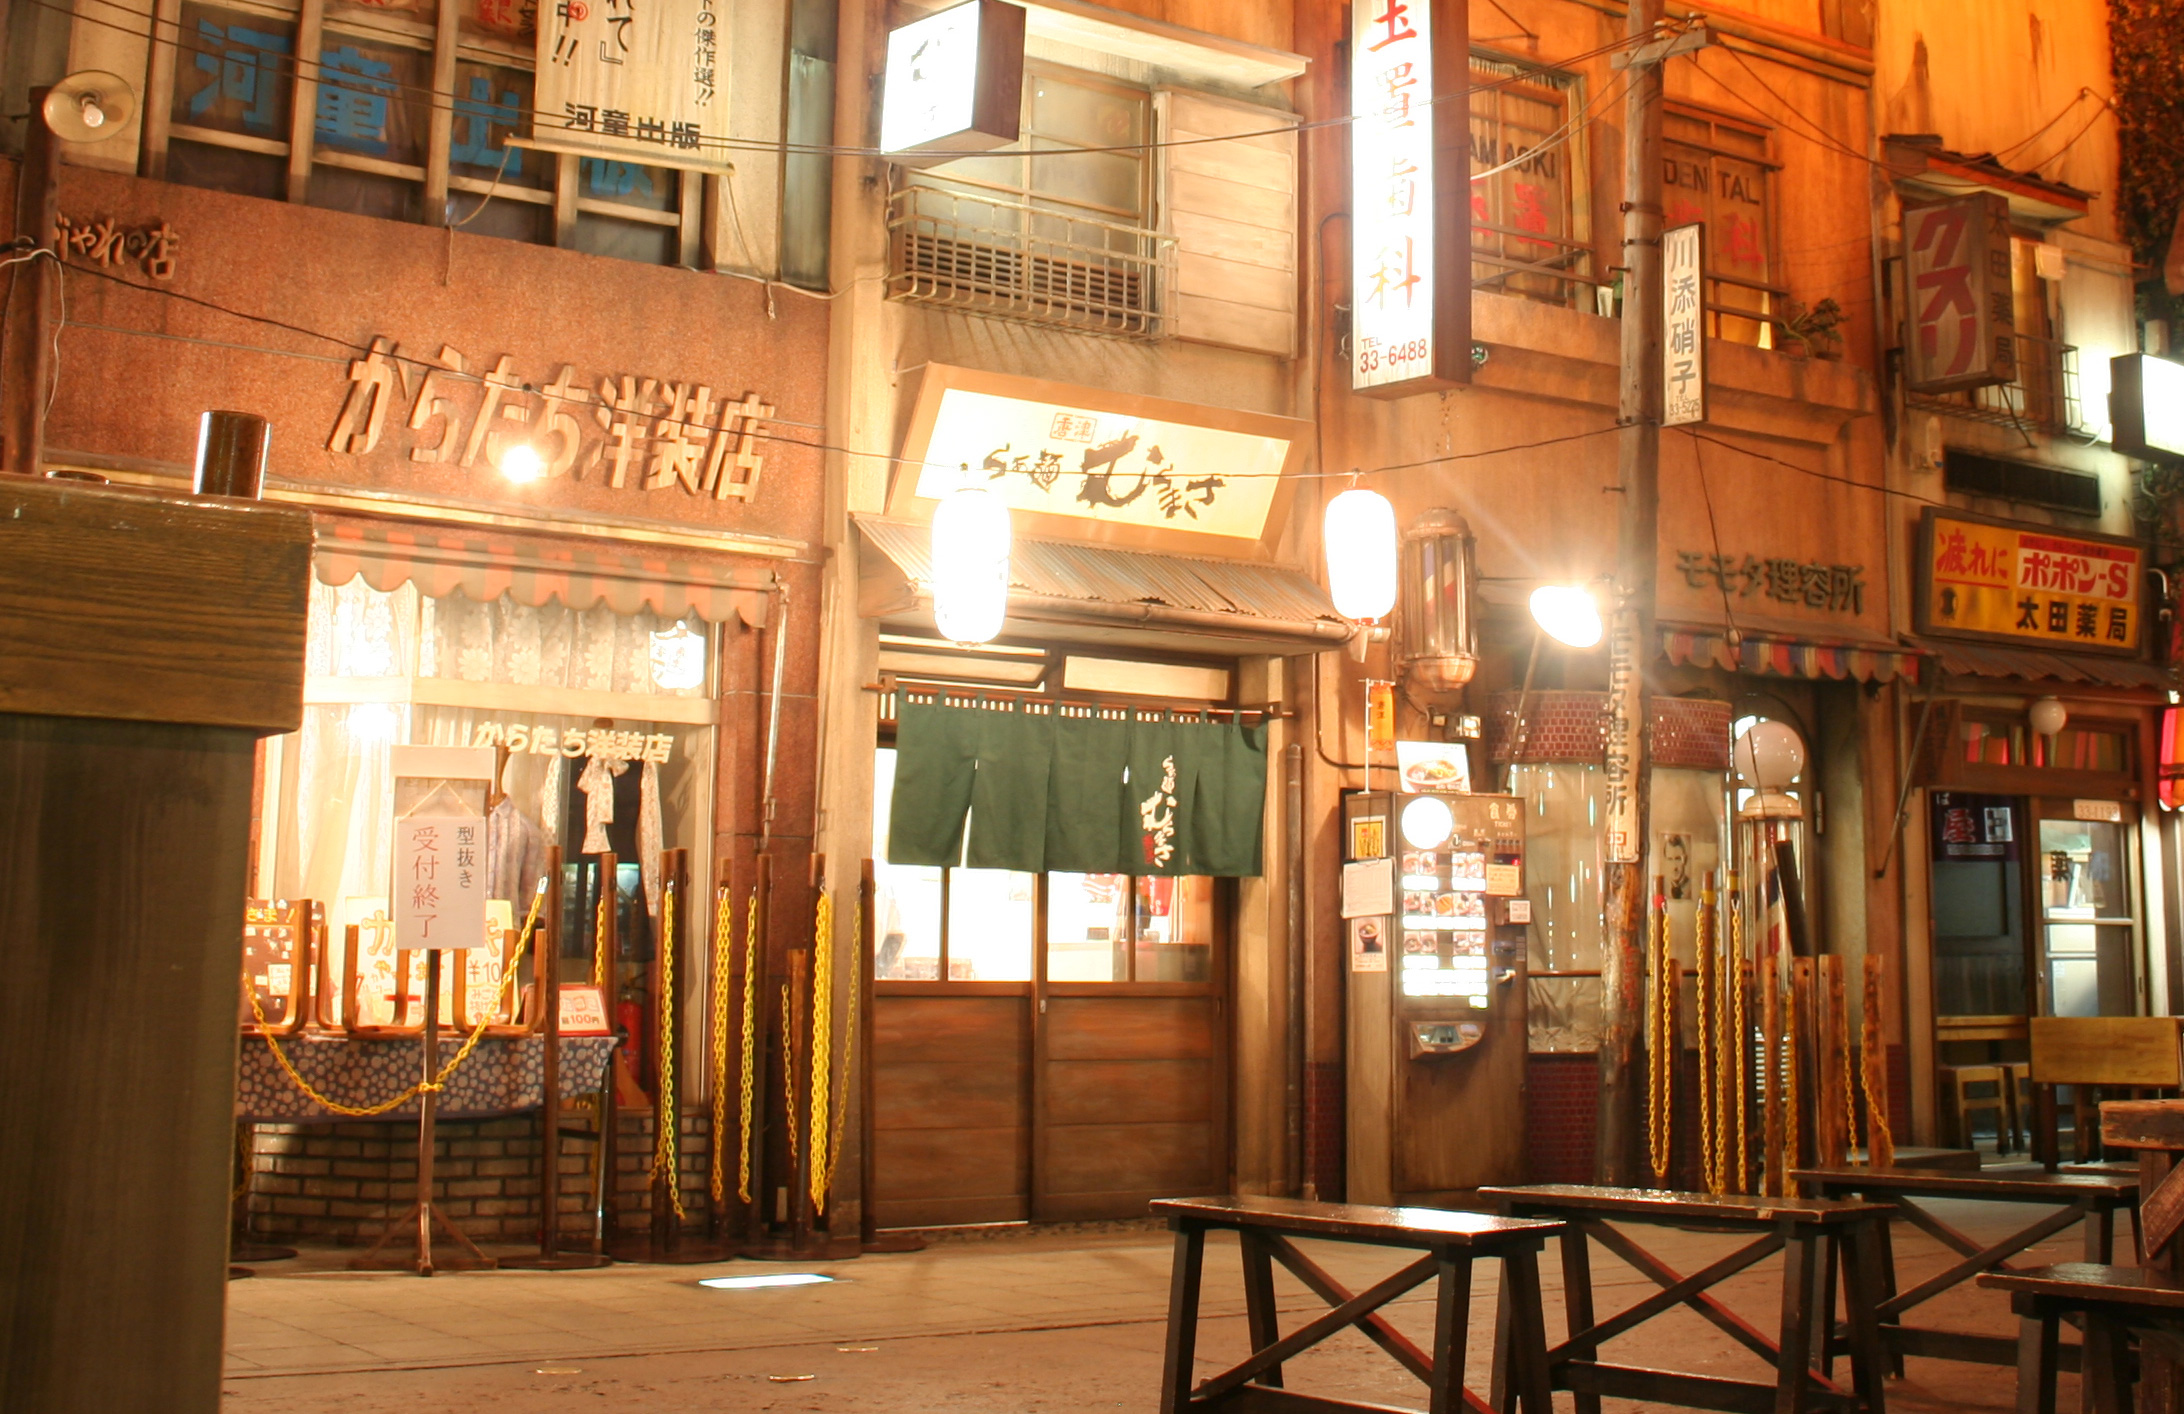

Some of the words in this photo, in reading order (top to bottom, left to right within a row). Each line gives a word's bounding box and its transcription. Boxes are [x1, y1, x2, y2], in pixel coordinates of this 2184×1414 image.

[564, 101, 701, 151] 河童出版
[1669, 235, 1698, 395] 川添硝子
[1912, 202, 1979, 377] クスリ
[1359, 338, 1428, 374] 33-6488
[1361, 337, 1383, 349] TEL
[326, 335, 777, 504] からたち洋装店
[1935, 528, 2009, 582] 疲れに
[2016, 595, 2129, 642] 太田薬局
[473, 720, 675, 764] からたち洋装店
[411, 825, 441, 940] 受付終了
[456, 825, 475, 888] 型抜き
